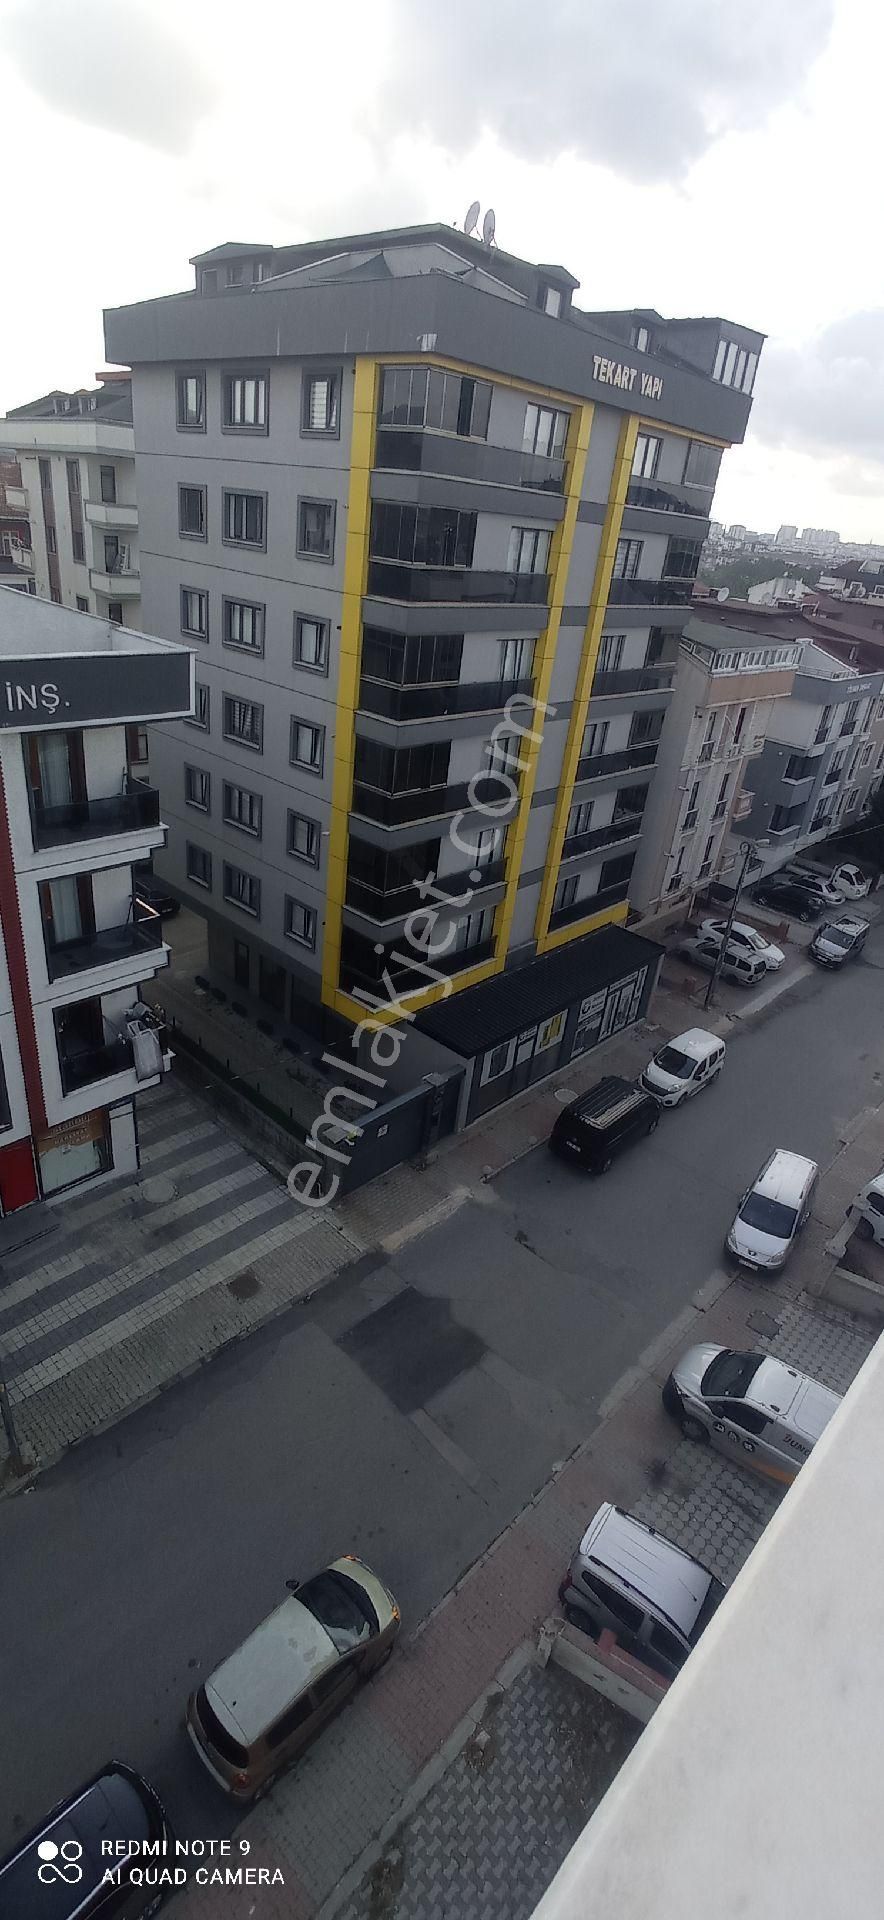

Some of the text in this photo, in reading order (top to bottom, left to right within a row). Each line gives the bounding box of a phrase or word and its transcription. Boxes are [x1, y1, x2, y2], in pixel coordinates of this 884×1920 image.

[593, 355, 663, 400] TEKART YAPI
[5, 682, 70, 714] İNŞ.
